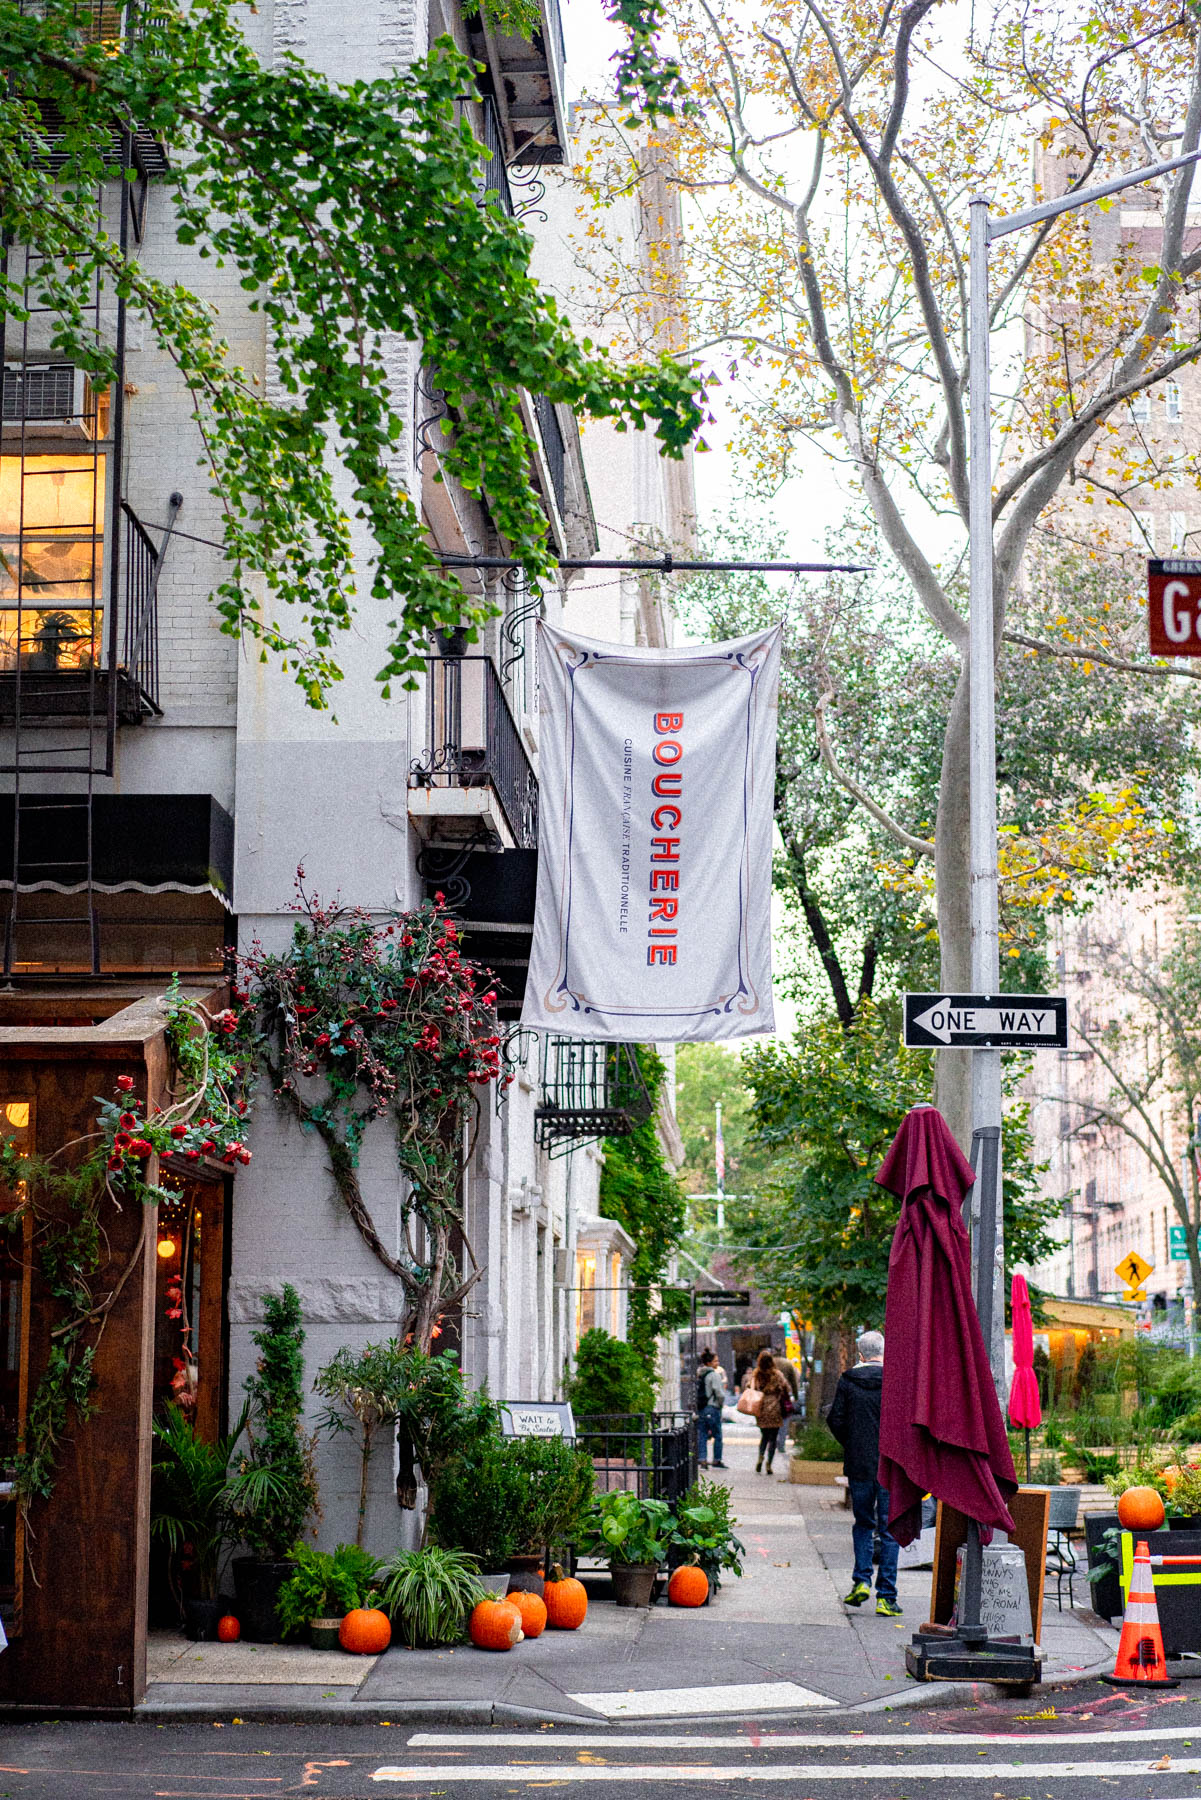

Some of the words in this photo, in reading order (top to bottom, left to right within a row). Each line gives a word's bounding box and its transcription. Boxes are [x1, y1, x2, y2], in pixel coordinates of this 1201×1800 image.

[1163, 580, 1201, 643] G
[623, 738, 633, 782] CUISINE
[622, 785, 632, 841] FRANÇAISE
[647, 712, 684, 966] BOUCHERIE
[619, 843, 630, 933] TRADITIONNELLE
[931, 1011, 976, 1031] ONE
[999, 1011, 1046, 1032] WAY
[519, 1415, 543, 1424] WAIT
[519, 1424, 530, 1432] Be
[533, 1424, 557, 1432] Seated
[998, 1588, 1013, 1598] ME
